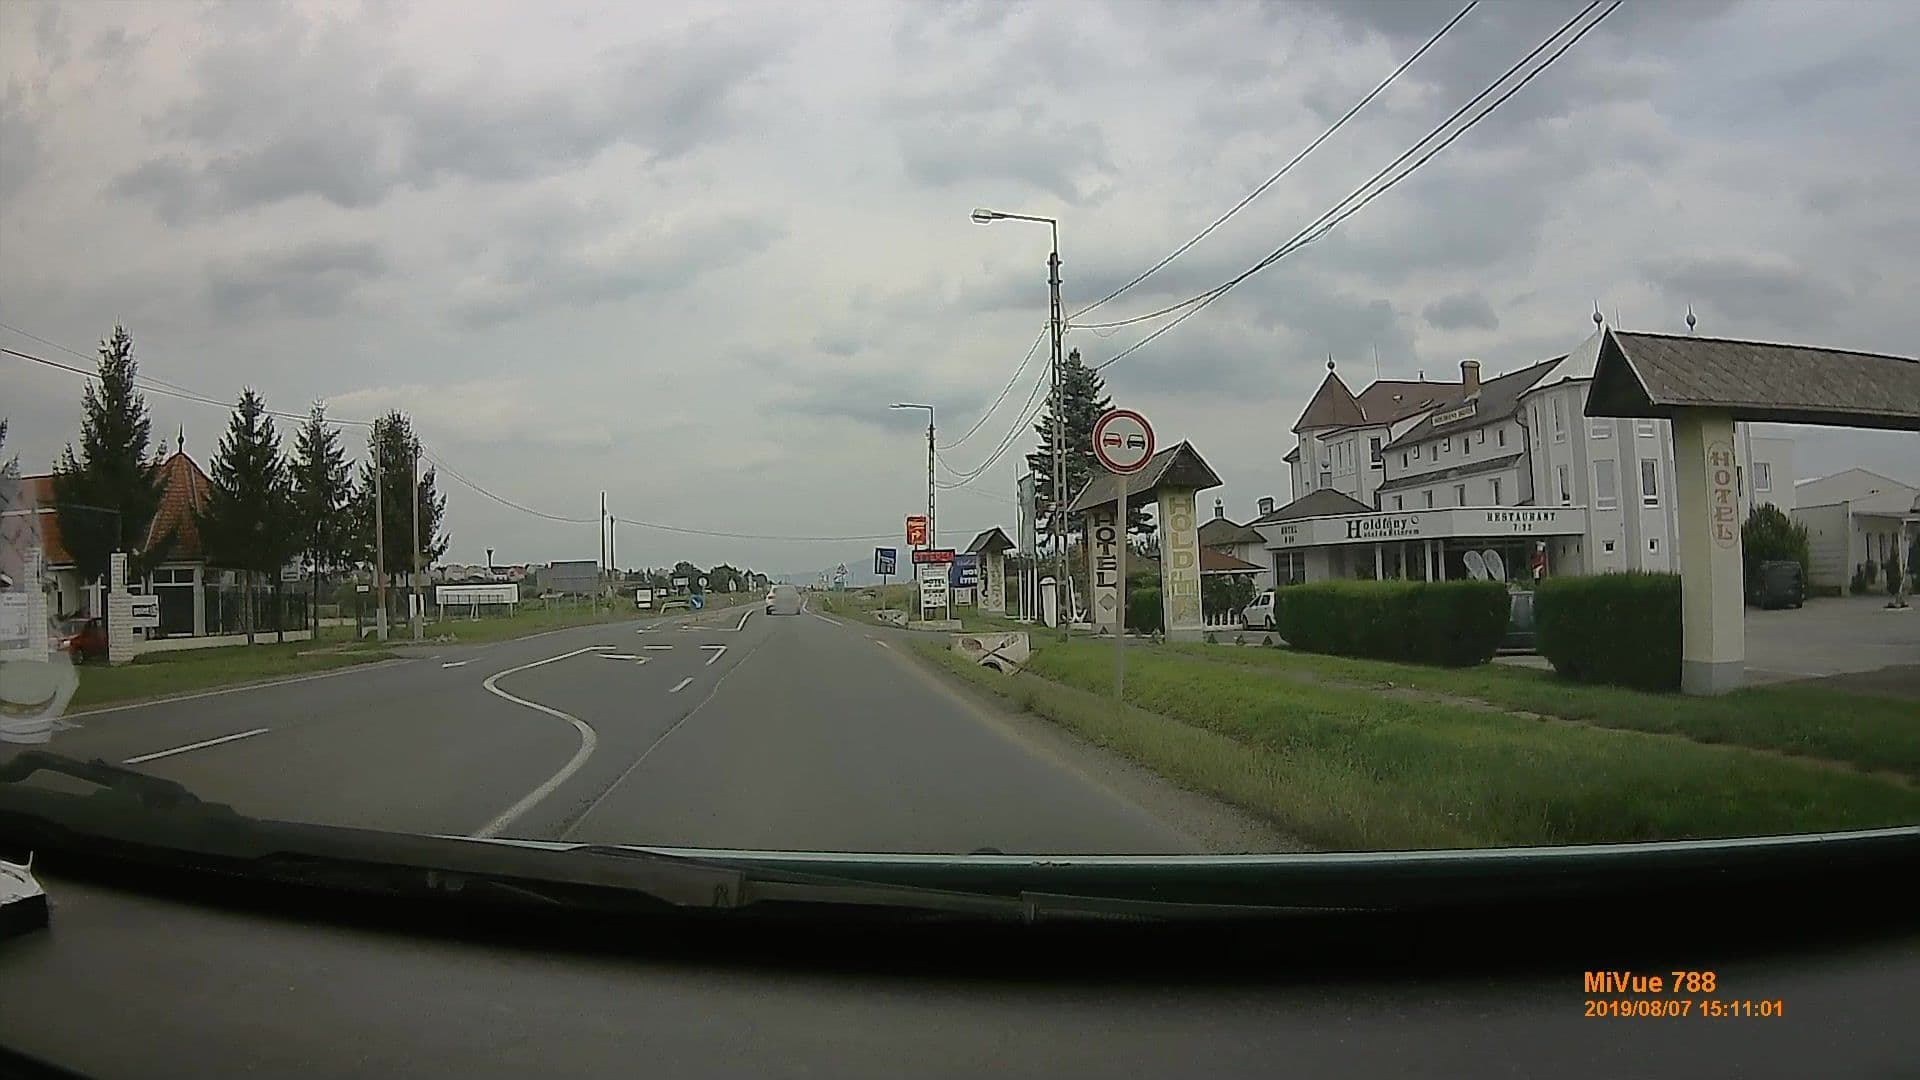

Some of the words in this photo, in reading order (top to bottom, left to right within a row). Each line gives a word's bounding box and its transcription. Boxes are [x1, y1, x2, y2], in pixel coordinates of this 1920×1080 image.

[1486, 512, 1556, 522] RESTAURANT
[1711, 451, 1733, 540] HOTEL
[1094, 511, 1117, 588] HOTEL
